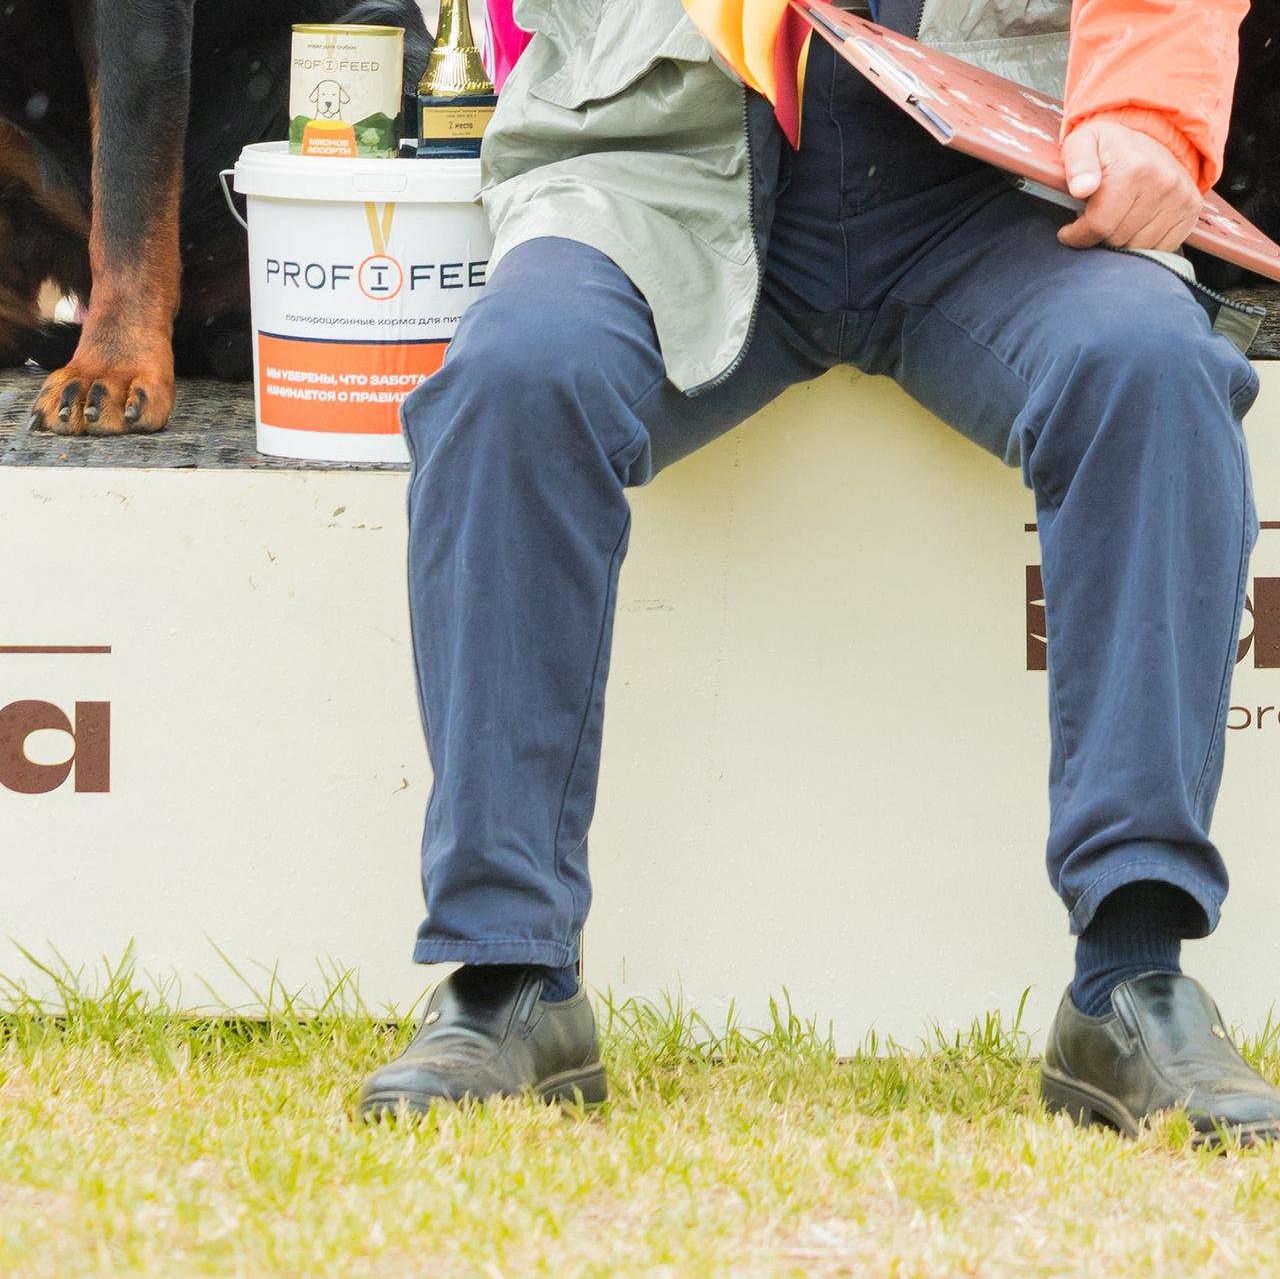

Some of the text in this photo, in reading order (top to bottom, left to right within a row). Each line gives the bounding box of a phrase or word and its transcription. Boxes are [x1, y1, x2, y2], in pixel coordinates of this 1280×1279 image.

[308, 138, 350, 147] МЯСНОЕ
[306, 146, 352, 155] АССОРТИ
[266, 257, 489, 291] PROFIFEE
[285, 313, 463, 327] полнорационные корма для пит
[338, 374, 367, 385] ЧТО
[370, 374, 428, 386] ЗАБОТА
[266, 384, 412, 404] НАЧИНАЕТСЯ С ПРАВИЛ
